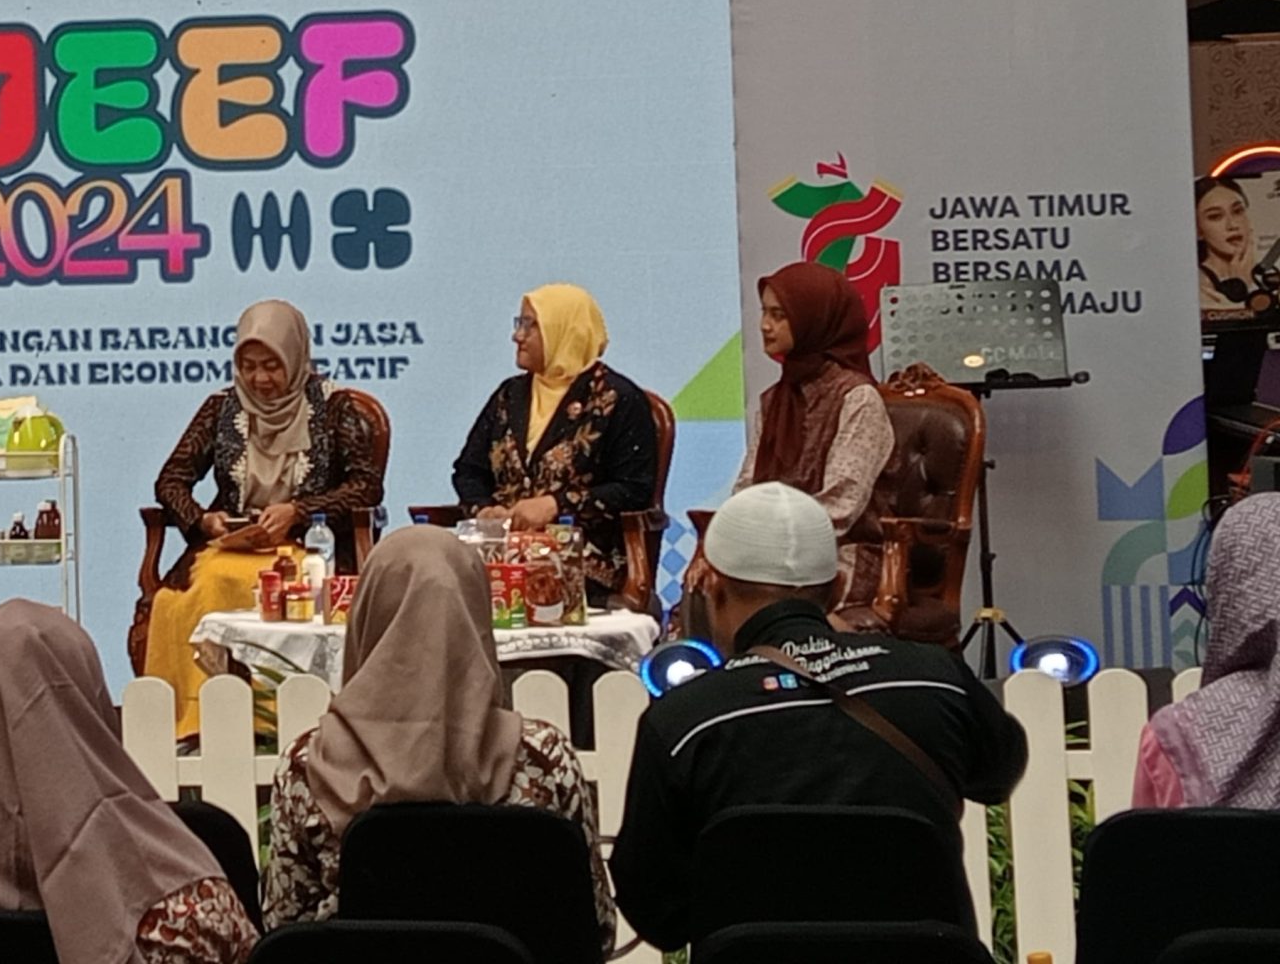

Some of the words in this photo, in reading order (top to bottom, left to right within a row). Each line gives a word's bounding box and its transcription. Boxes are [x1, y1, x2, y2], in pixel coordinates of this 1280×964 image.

[929, 195, 1020, 219] JAWA
[1027, 193, 1132, 217] TIMUR
[931, 227, 1070, 252] BERSATU
[932, 259, 1087, 284] BERSAMA
[330, 321, 423, 346] JASA
[9, 362, 80, 387] DAN
